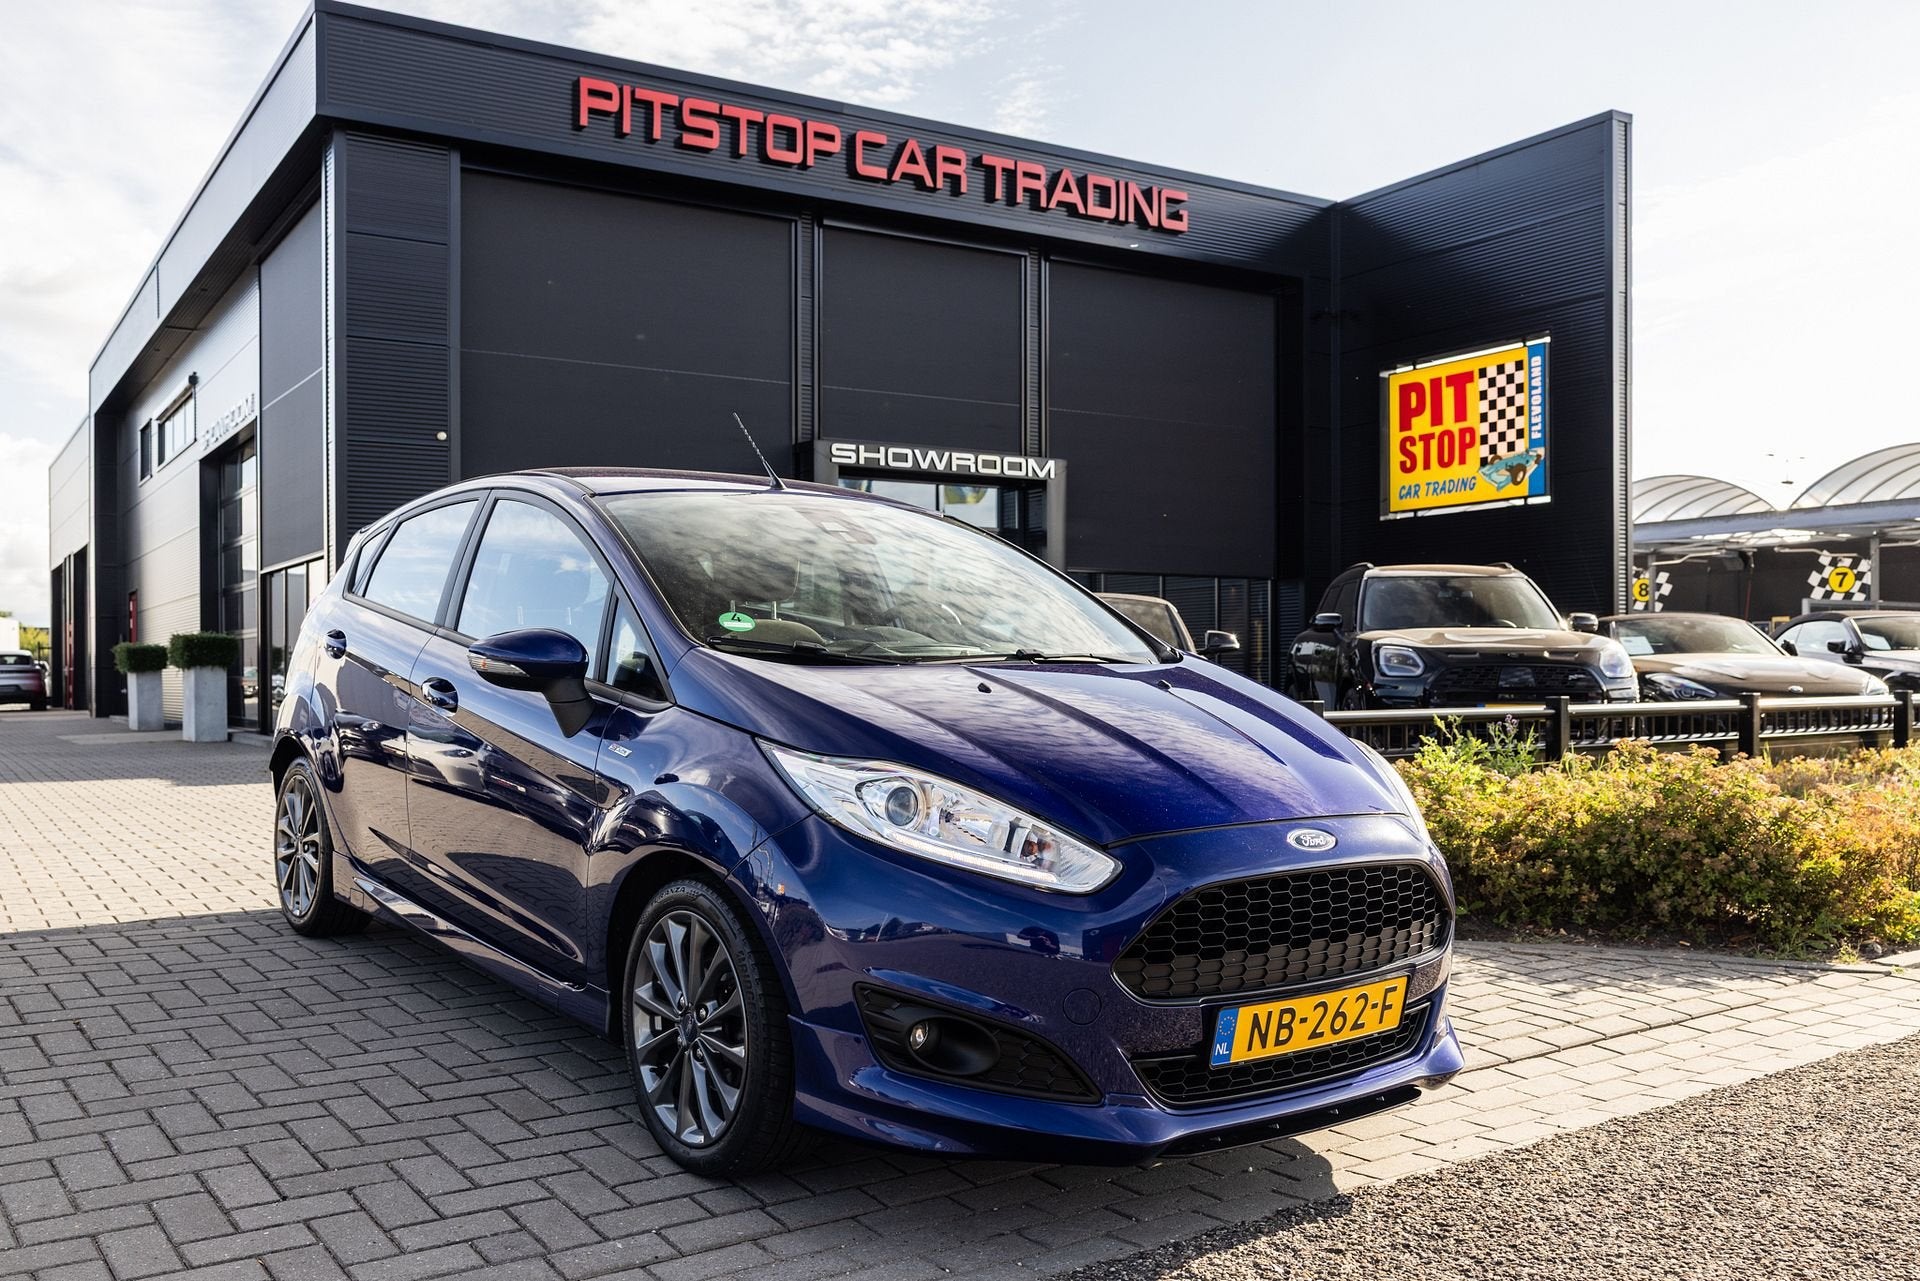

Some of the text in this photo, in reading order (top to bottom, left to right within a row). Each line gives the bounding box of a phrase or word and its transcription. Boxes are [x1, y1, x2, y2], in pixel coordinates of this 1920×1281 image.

[577, 76, 1189, 232] PITSTOP CAR TRADING
[1398, 370, 1475, 433] PIT
[1530, 355, 1542, 440] FLEVOLAND
[831, 442, 1056, 479] SHOWROOM
[1399, 426, 1476, 474] STOP
[1398, 476, 1477, 500] CAR TRADING
[1638, 582, 1649, 598] 8
[1835, 572, 1849, 588] 7
[731, 613, 742, 622] 4
[1214, 985, 1399, 1056] NL NB-262-F
